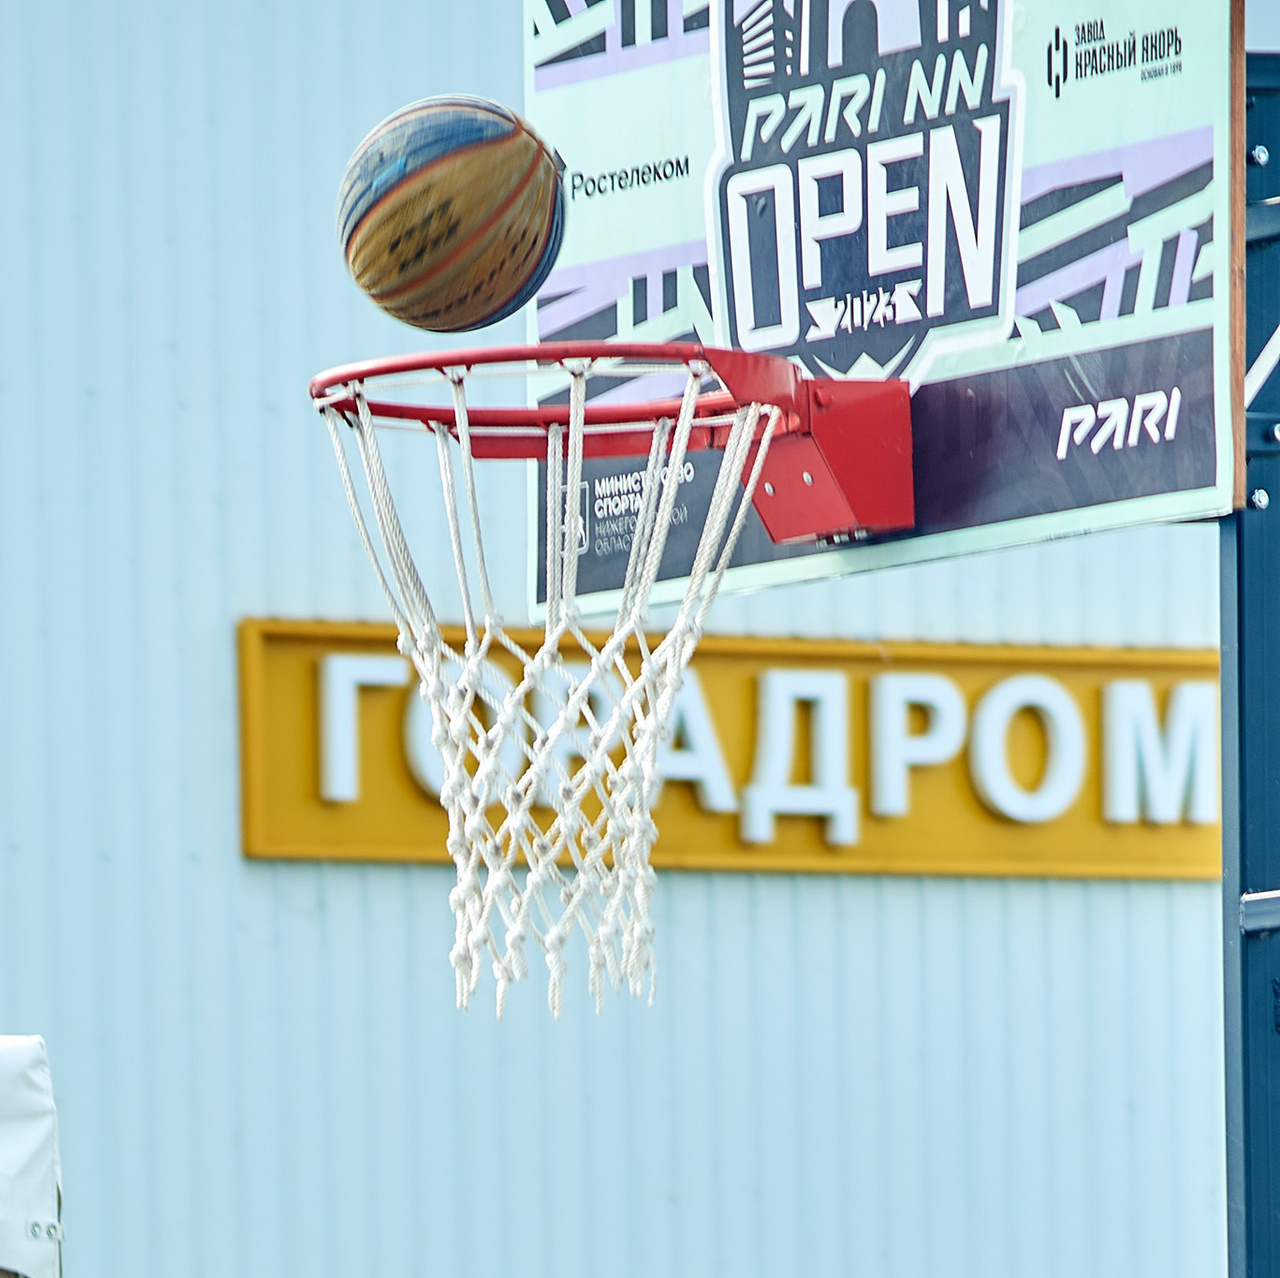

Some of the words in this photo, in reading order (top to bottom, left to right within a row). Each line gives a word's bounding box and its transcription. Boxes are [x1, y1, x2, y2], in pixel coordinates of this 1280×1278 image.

[1075, 18, 1105, 46] ЗАВОД
[1075, 30, 1136, 79] КРАСНЫЙ
[1141, 26, 1182, 63] ЯКОРЬ
[740, 67, 887, 162] PARI
[903, 43, 989, 125] NN
[571, 154, 689, 201] Ростелеком
[726, 113, 1001, 353] OPEN
[1056, 386, 1182, 460] PARI
